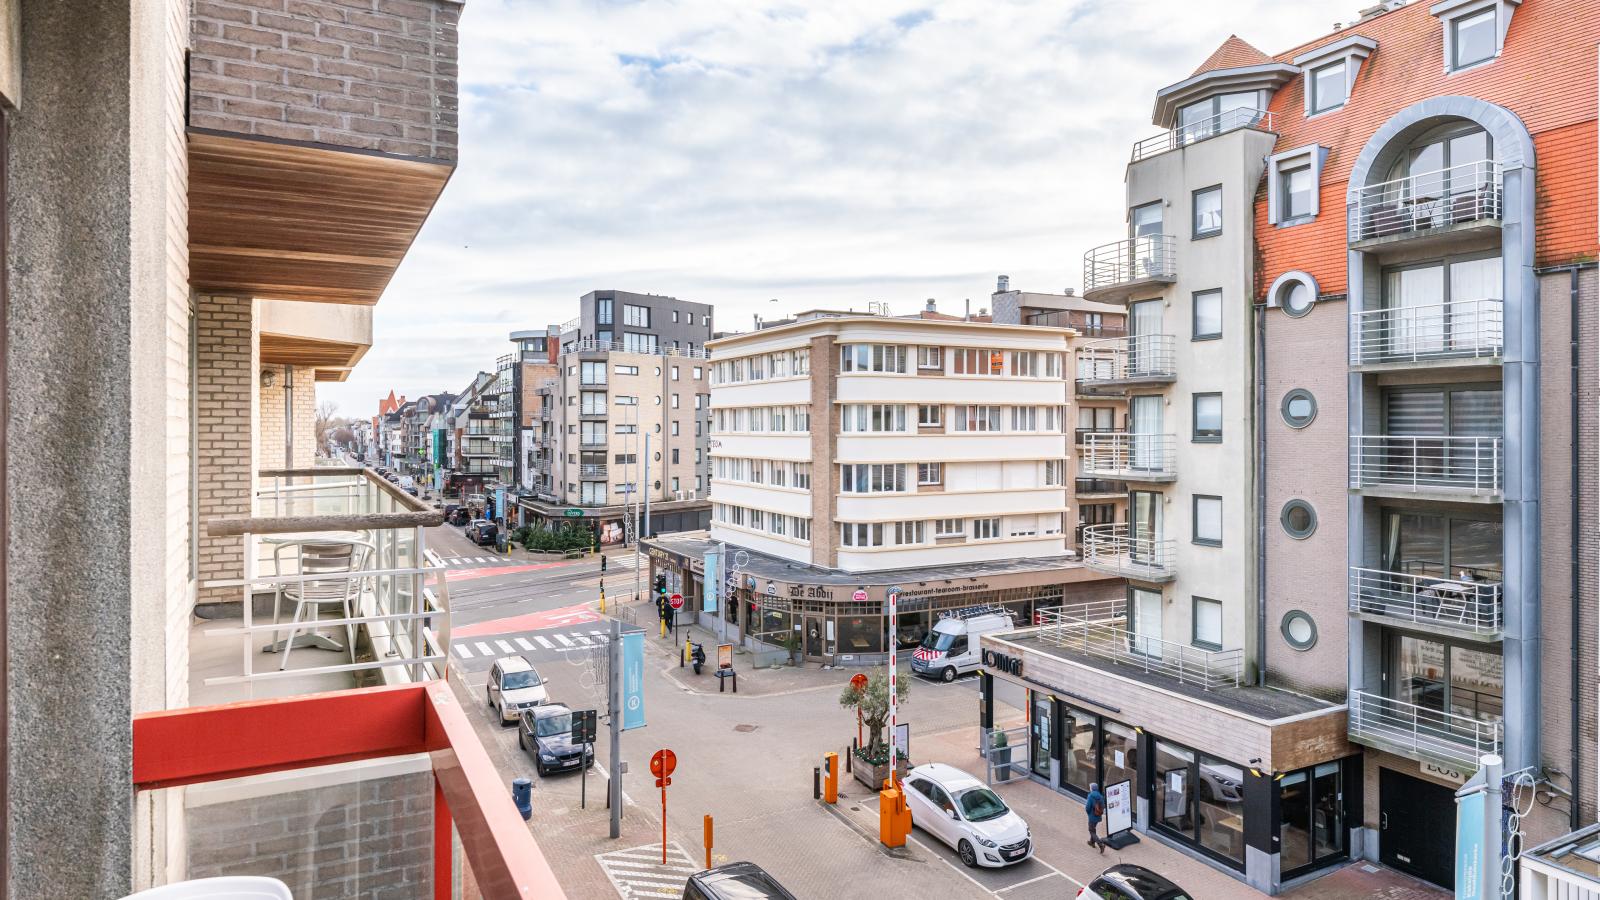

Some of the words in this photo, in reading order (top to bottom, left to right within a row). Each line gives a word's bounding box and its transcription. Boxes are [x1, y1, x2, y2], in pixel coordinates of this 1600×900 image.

[790, 586, 804, 597] De
[808, 587, 833, 600] Abdij
[902, 583, 989, 597] restaurant-tearoom-brasserie
